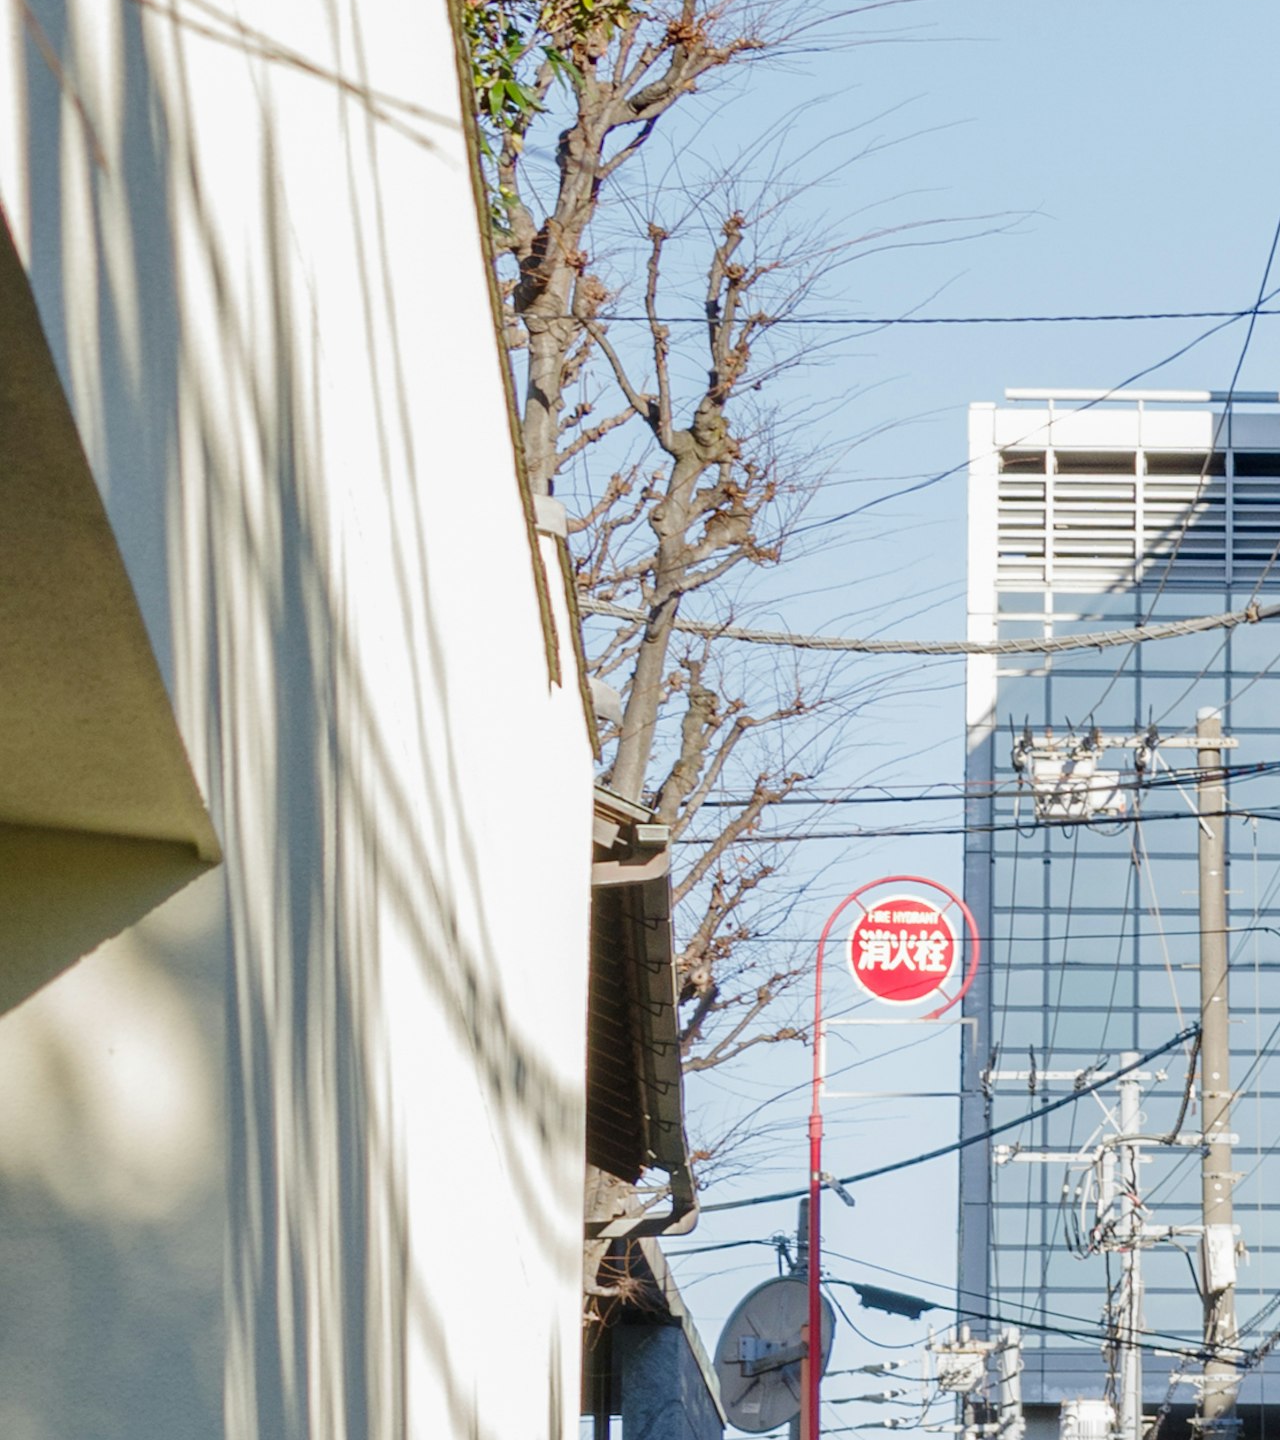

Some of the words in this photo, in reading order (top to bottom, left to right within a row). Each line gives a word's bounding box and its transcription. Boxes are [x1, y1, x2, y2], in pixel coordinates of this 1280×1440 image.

[868, 910, 891, 924] FIRE
[892, 911, 939, 925] HYDRANT
[858, 929, 949, 972] 消火栓
